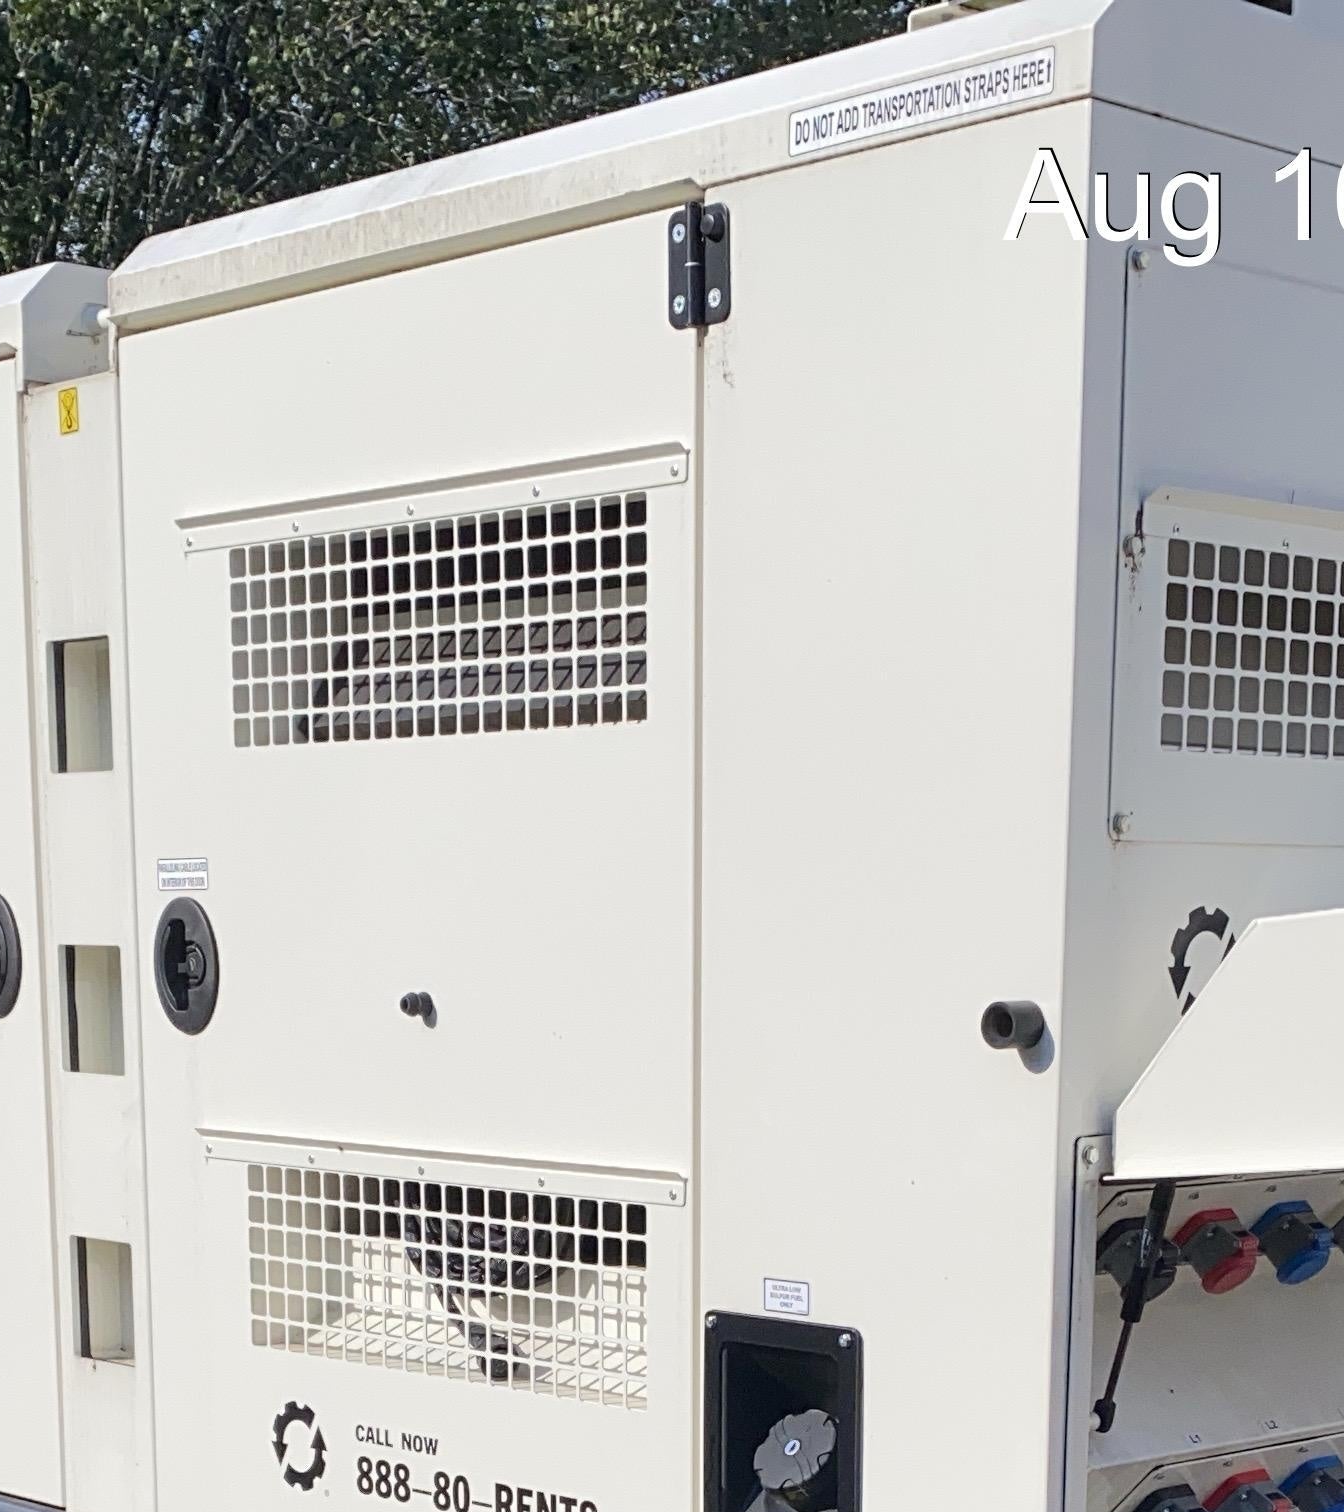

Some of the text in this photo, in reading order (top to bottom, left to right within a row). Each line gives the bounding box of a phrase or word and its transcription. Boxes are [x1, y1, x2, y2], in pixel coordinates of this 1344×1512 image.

[794, 58, 1044, 146] DO NOT ADD TRANSPORTATION STRAPS HERE
[355, 1424, 439, 1456] CALL NOW
